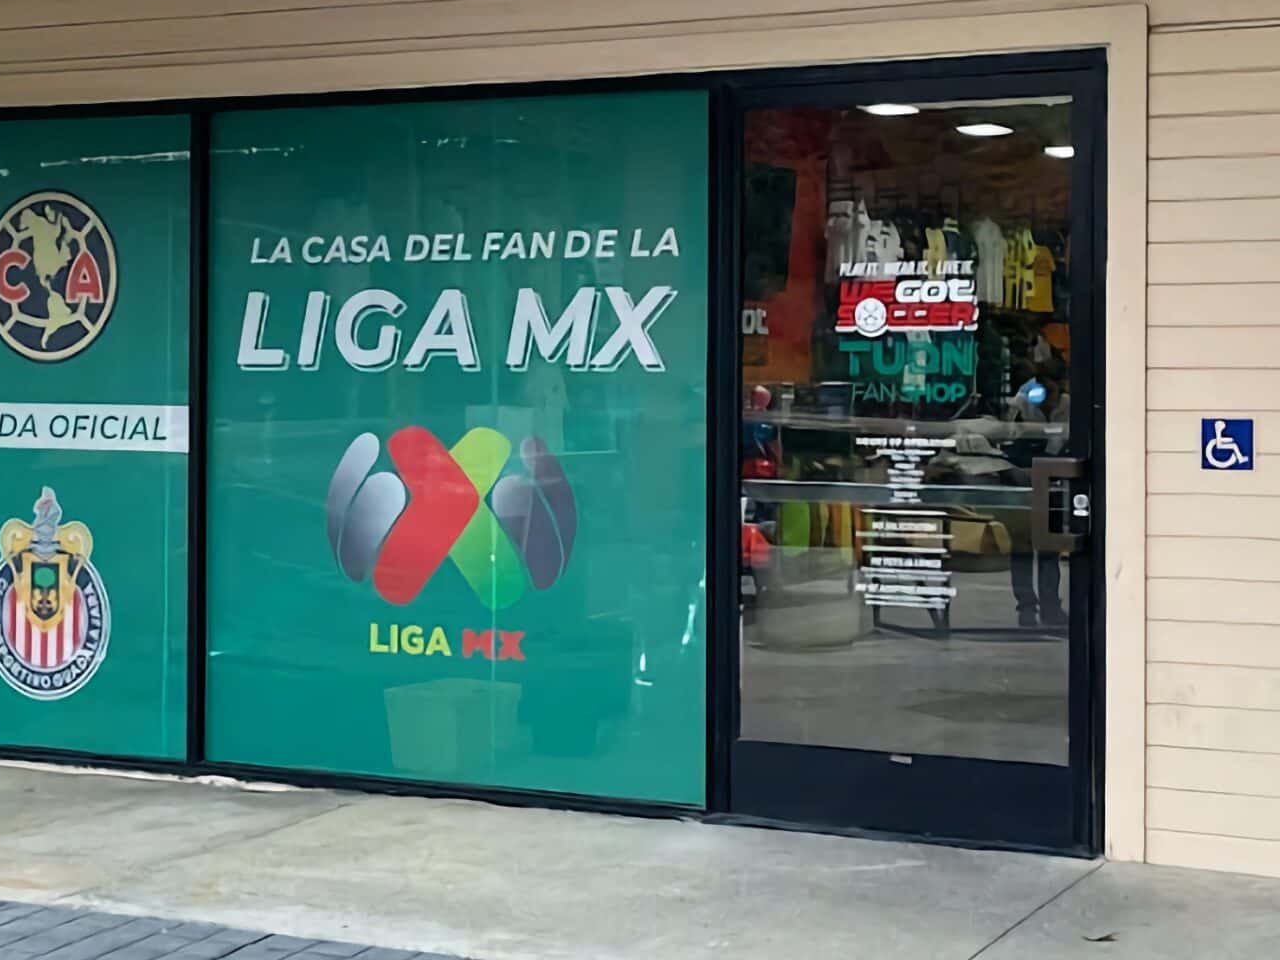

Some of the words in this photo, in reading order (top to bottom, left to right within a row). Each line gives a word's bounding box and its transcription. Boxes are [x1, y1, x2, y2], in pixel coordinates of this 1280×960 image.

[250, 237, 293, 265] LA
[300, 235, 391, 264] CASA
[404, 233, 473, 262] DEL
[482, 231, 556, 260] FAN
[564, 229, 619, 259] DE
[630, 227, 681, 258] LA
[237, 288, 482, 372] LIGA
[505, 285, 679, 372] MX
[851, 383, 895, 401] FAN
[900, 382, 967, 403] SHOP
[48, 414, 168, 441] OFICIAL
[369, 623, 452, 656] LIGA
[461, 628, 527, 660] MX
